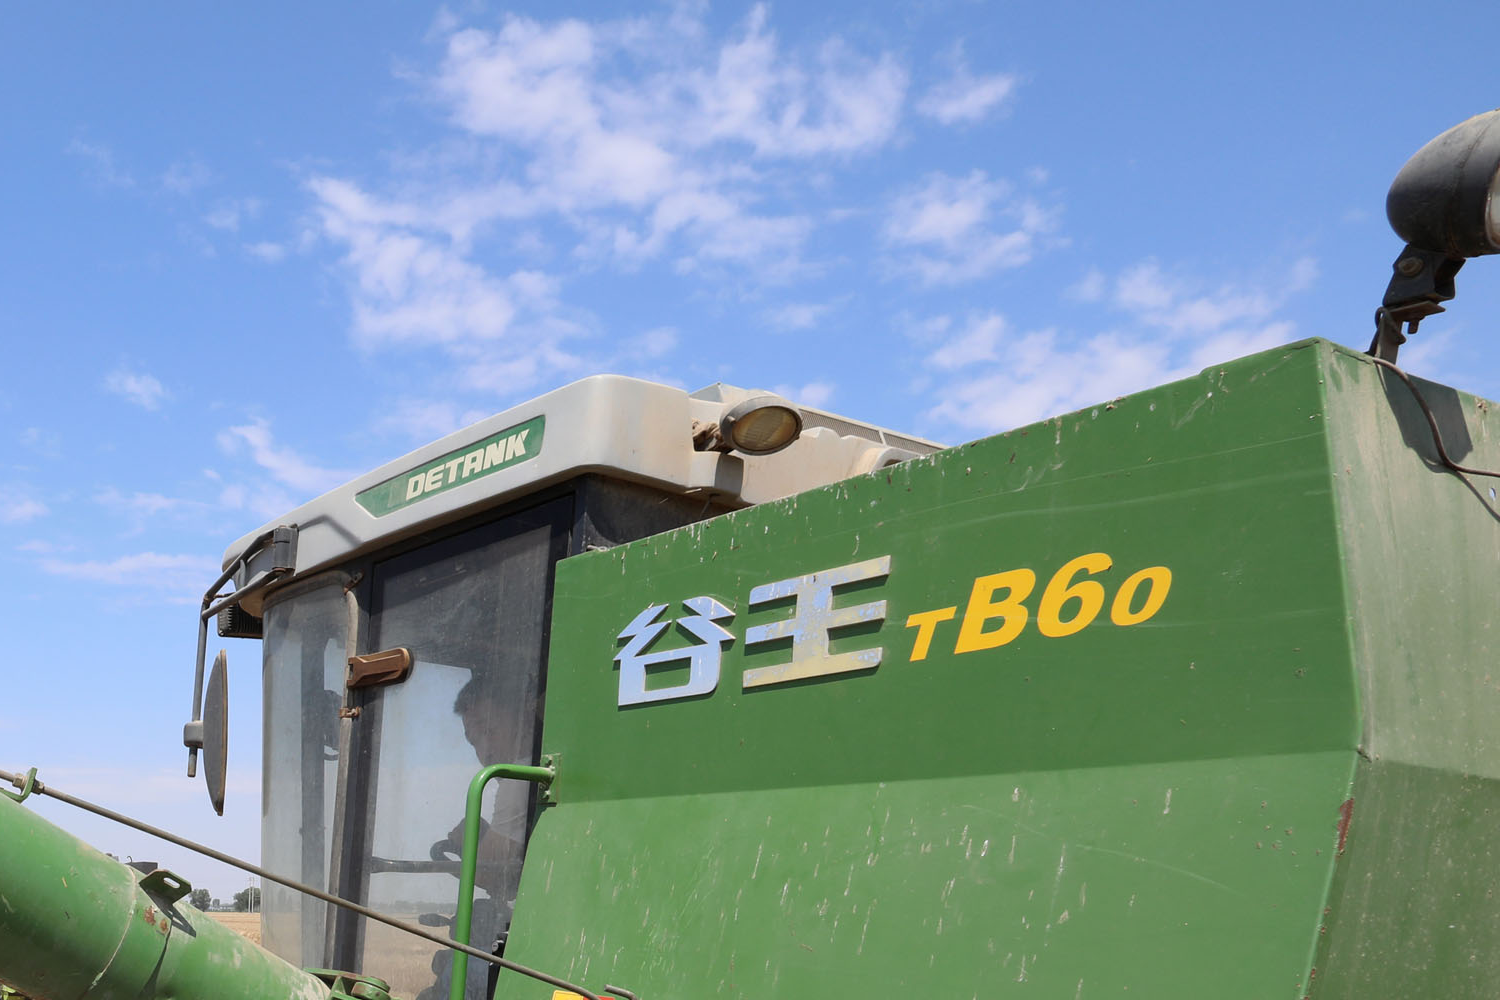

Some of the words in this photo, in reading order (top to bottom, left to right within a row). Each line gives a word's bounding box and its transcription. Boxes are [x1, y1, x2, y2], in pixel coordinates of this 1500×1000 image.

[405, 428, 530, 501] DETANK
[612, 554, 891, 706] 谷王
[905, 552, 1172, 662] TB60
